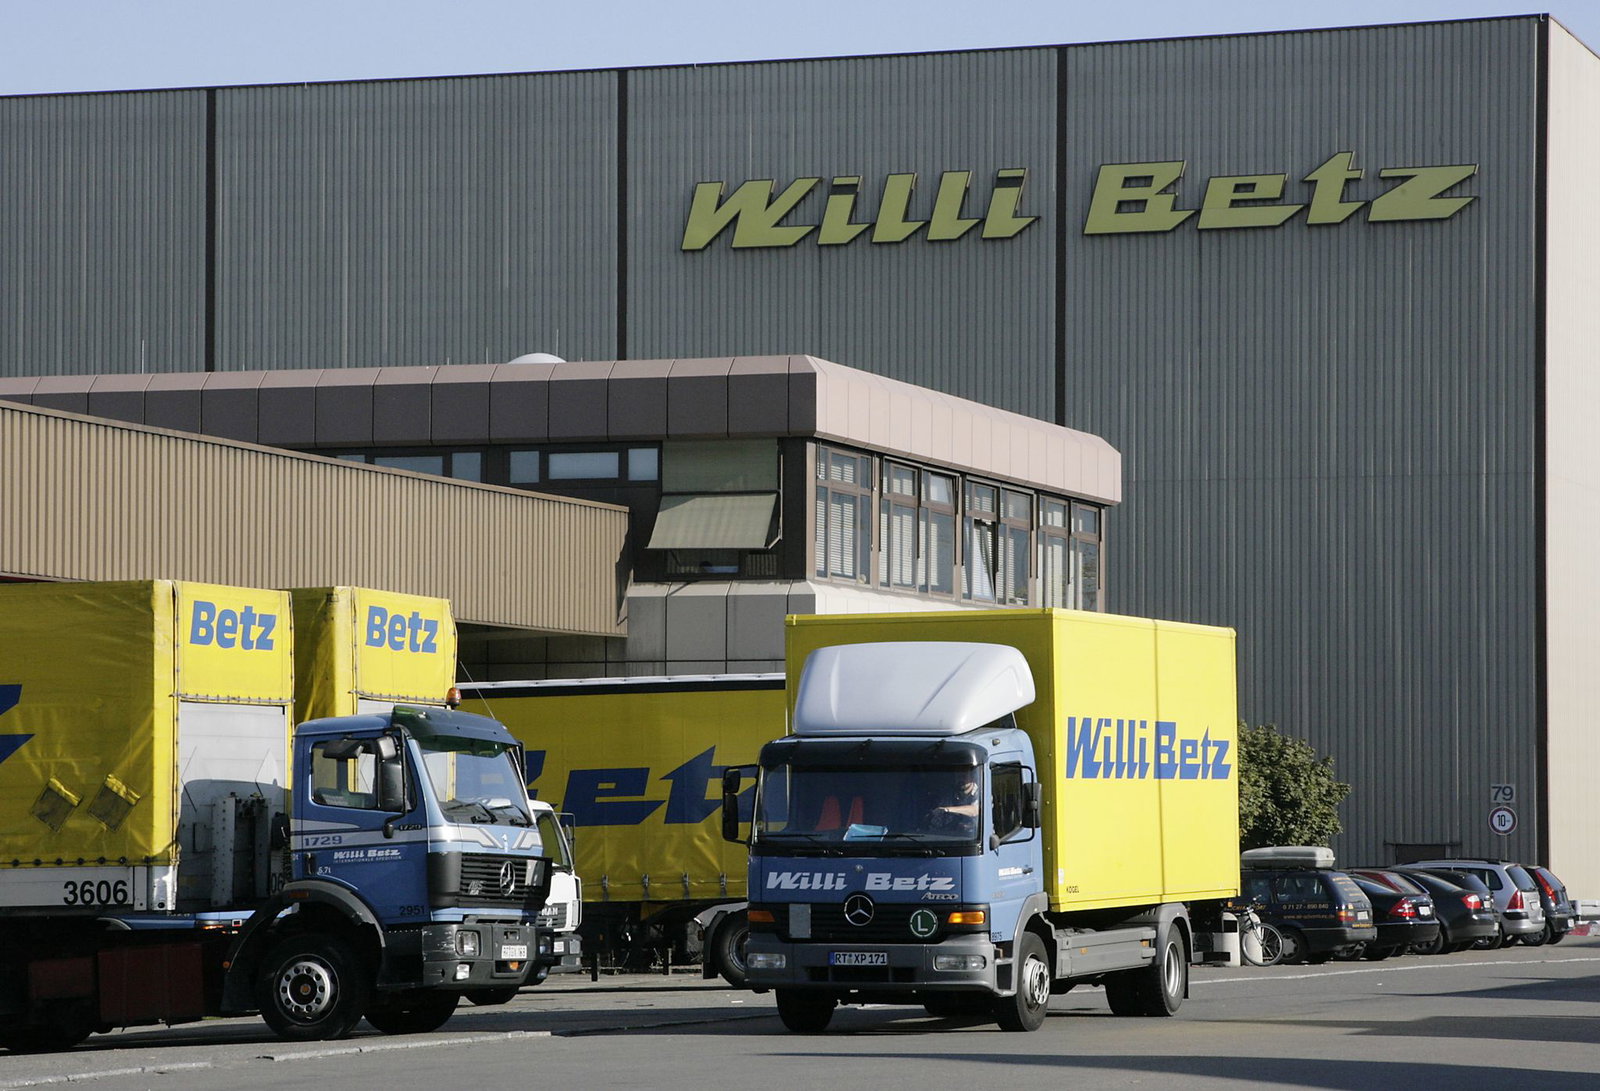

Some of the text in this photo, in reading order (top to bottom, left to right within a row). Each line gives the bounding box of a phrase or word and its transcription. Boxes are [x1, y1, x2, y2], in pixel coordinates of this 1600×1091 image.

[681, 151, 1479, 251] Willi Betz
[190, 600, 276, 650] Betz
[365, 605, 438, 654] Betz
[1066, 717, 1231, 779] Willi Betz
[1491, 786, 1514, 801] 79
[1497, 815, 1505, 826] 10
[304, 835, 342, 846] 1729
[334, 849, 401, 859] Willi Betz
[766, 872, 955, 890] Willi Betz
[63, 880, 128, 905] 3606
[399, 905, 425, 915] 2951
[541, 907, 558, 916] MAN
[918, 915, 928, 931] L
[835, 953, 886, 964] RT XP 171
